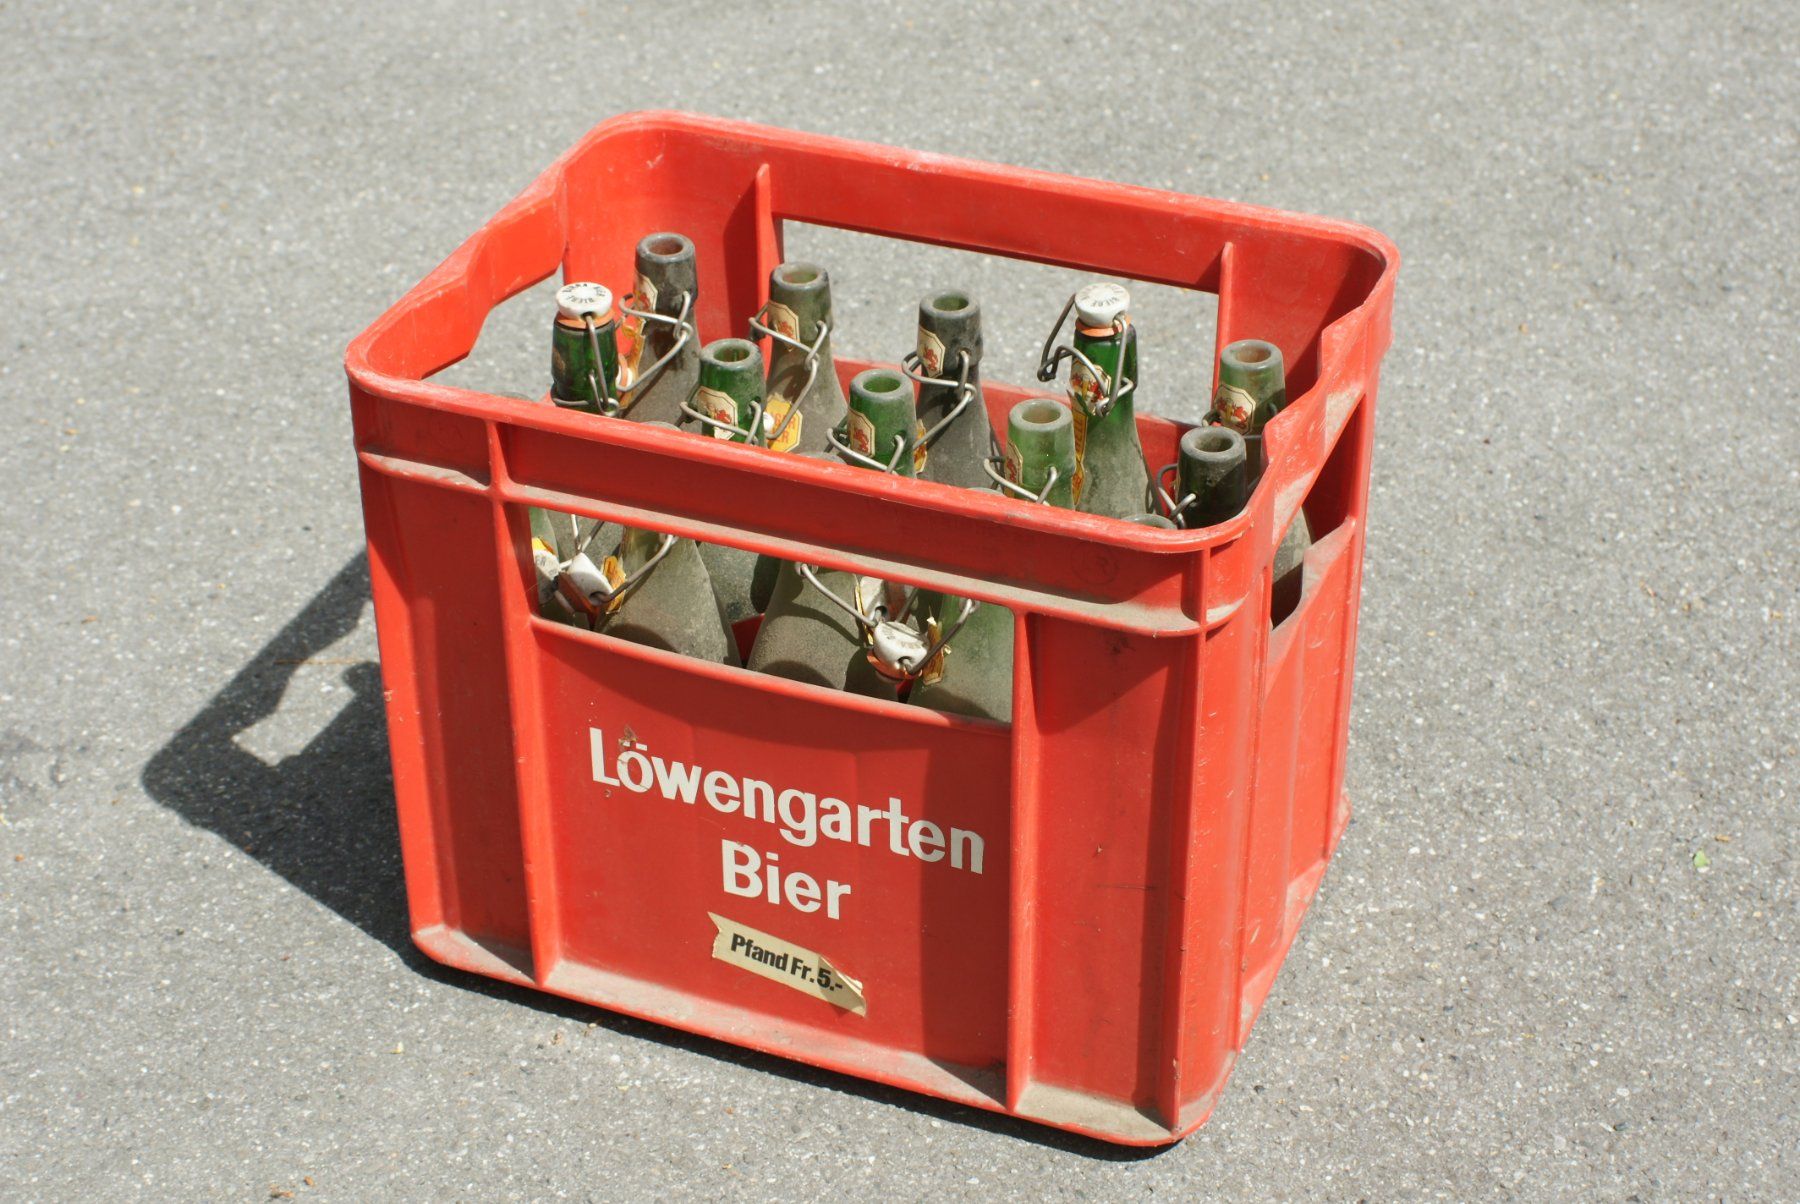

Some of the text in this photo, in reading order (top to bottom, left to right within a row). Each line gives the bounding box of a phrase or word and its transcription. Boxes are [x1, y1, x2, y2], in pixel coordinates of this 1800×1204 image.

[589, 727, 985, 874] Löwengarten
[721, 839, 851, 920] Bier
[731, 933, 788, 971] Pfand
